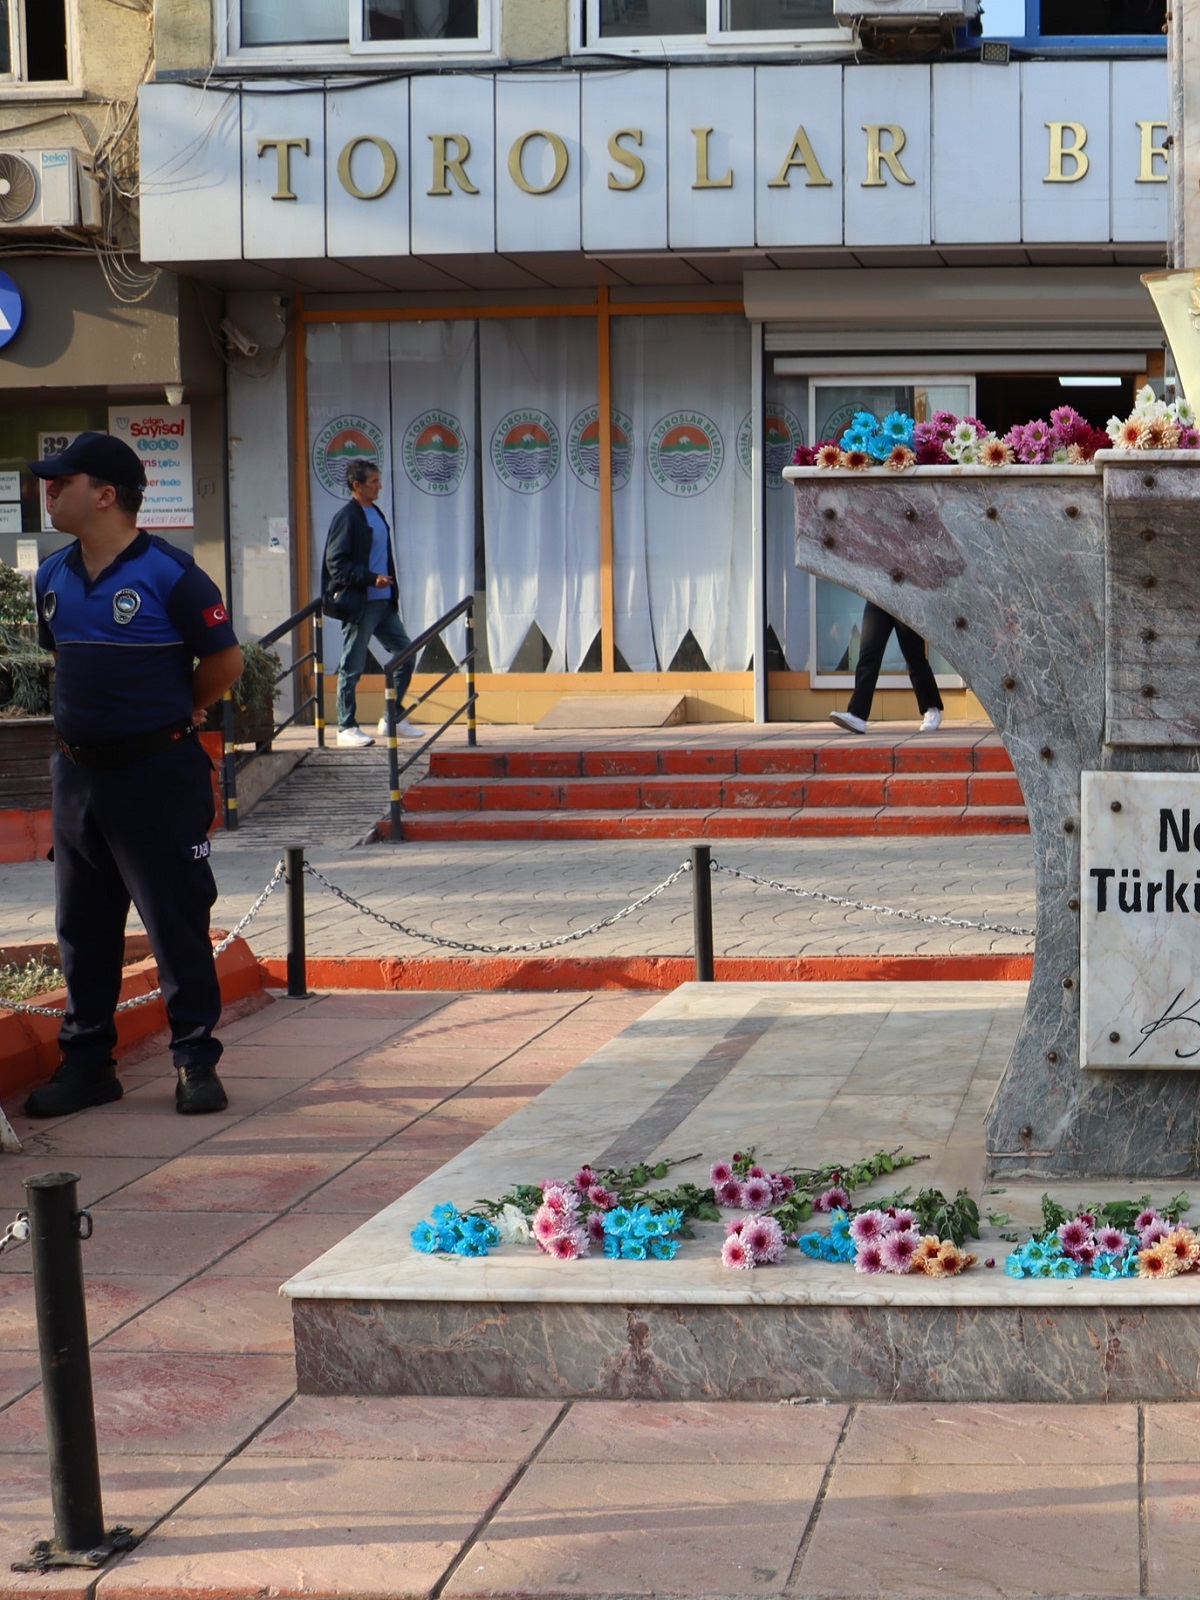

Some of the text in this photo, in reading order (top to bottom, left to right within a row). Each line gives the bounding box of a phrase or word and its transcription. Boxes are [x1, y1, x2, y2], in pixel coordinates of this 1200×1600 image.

[42, 153, 68, 163] beko
[257, 121, 916, 201] TOROSLAR
[654, 414, 704, 439] TOROSLAR
[675, 483, 699, 493] 1994
